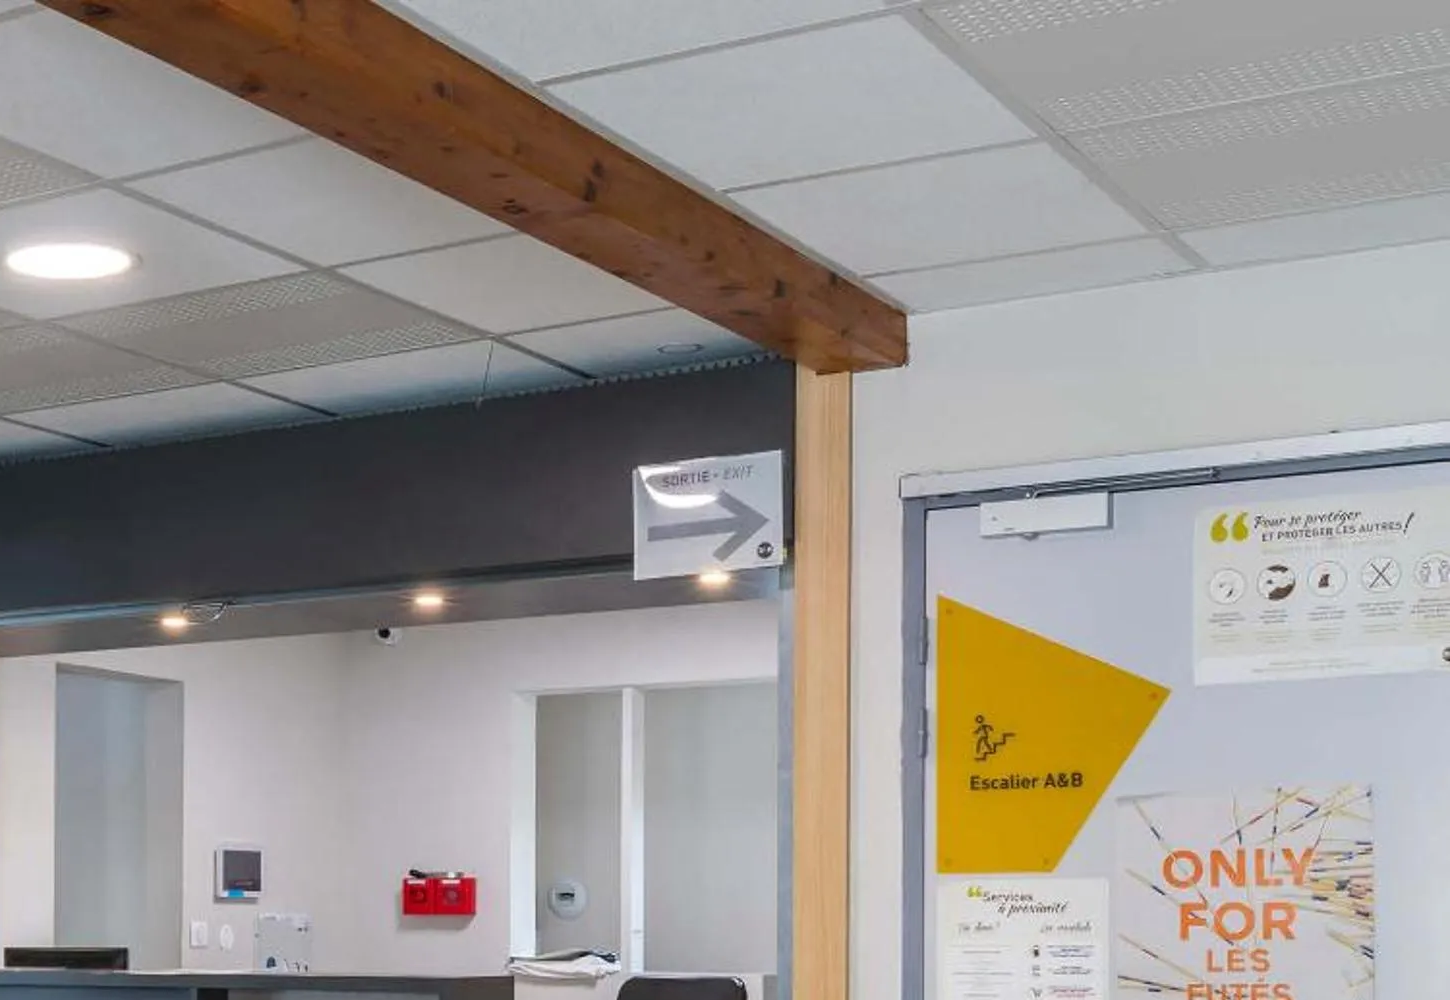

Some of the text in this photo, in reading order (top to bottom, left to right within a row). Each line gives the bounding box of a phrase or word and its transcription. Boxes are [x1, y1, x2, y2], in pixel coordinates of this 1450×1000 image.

[662, 465, 754, 488] SORTIE EXIT
[1261, 531, 1274, 543] ET
[1335, 524, 1357, 536] LES
[970, 772, 1083, 791] Escalier A&B
[1162, 847, 1315, 890] ONLY
[1179, 901, 1297, 941] FOR
[1206, 948, 1270, 972] LES
